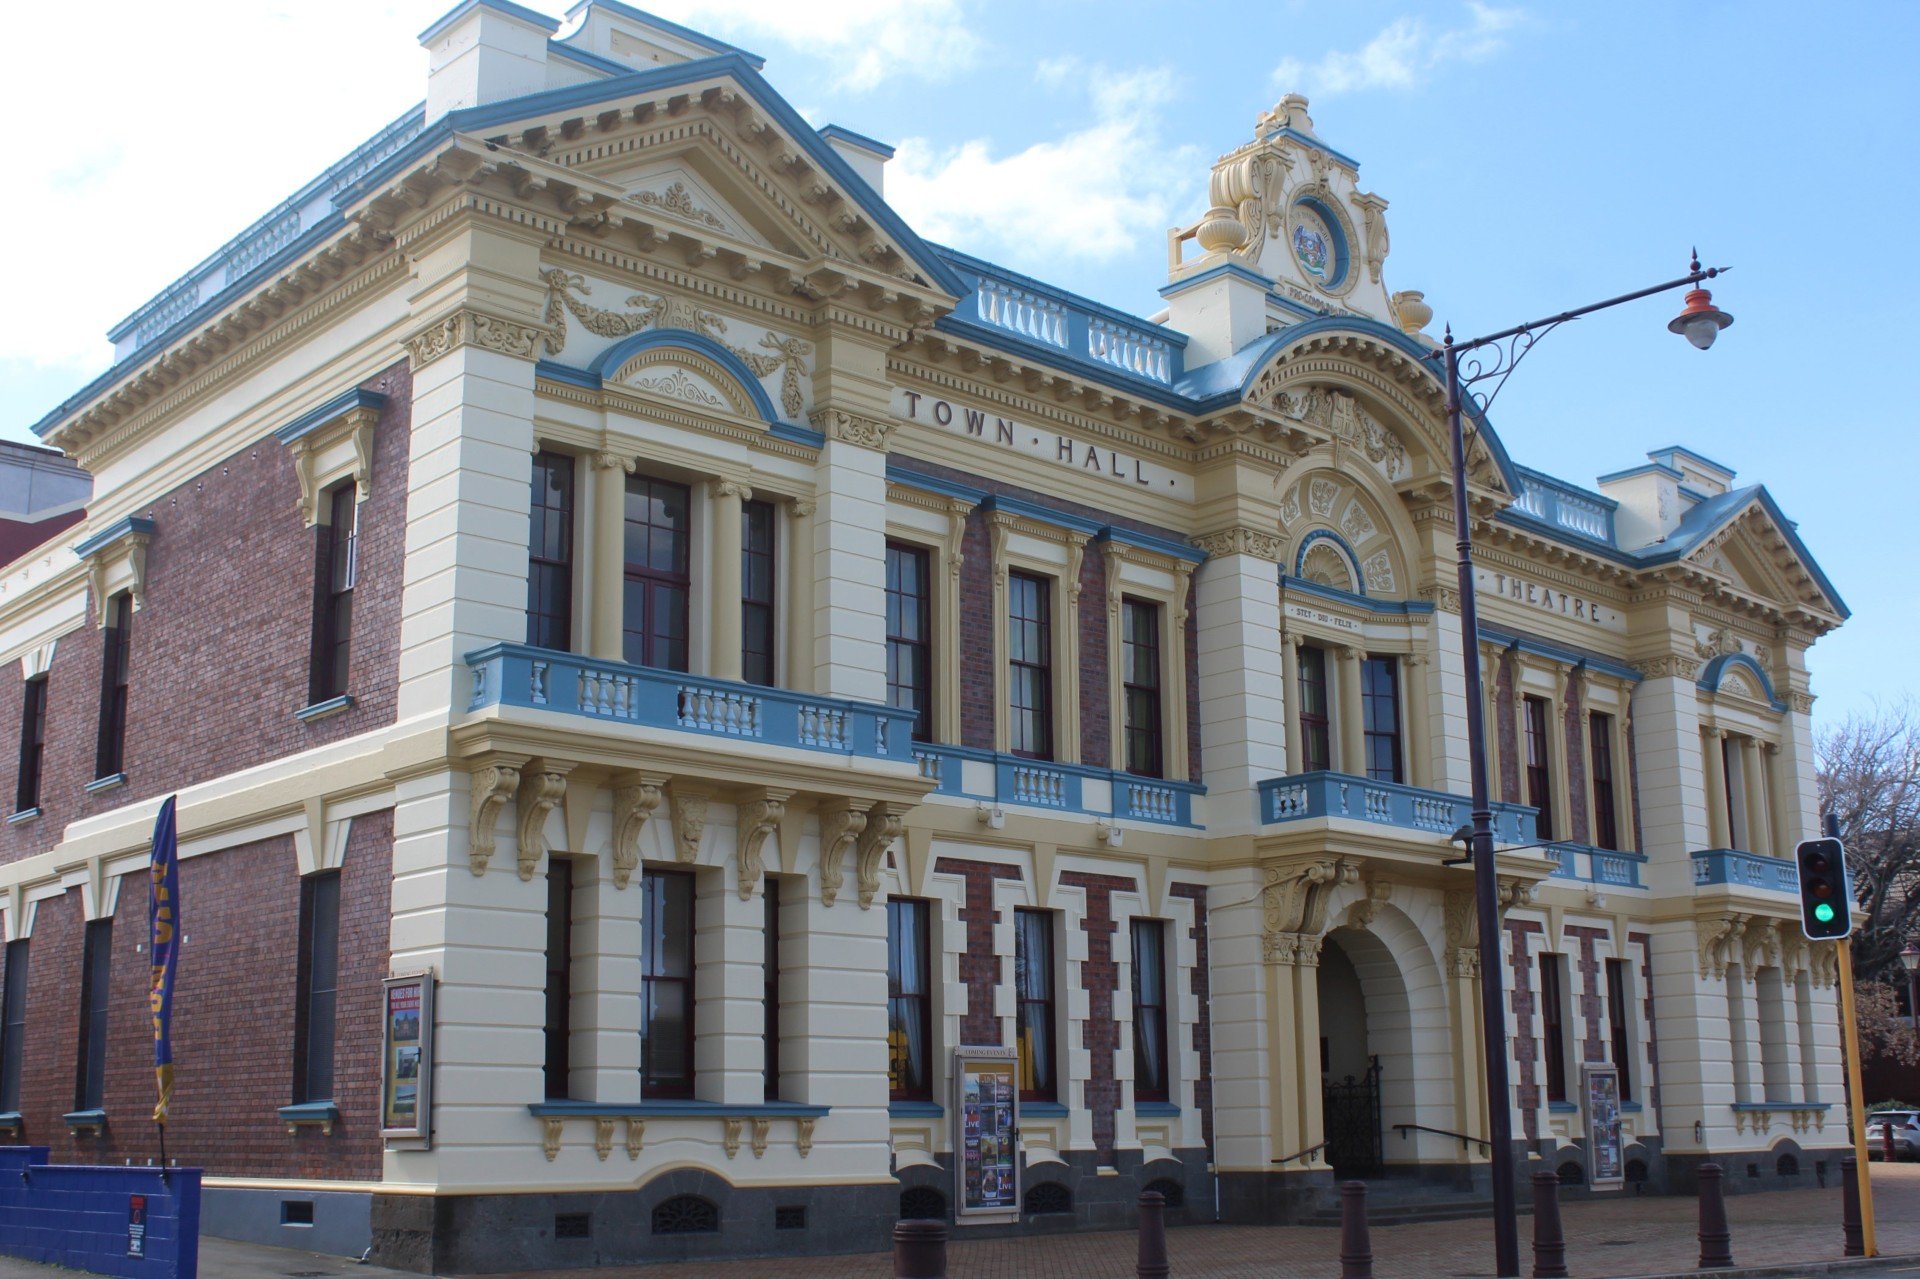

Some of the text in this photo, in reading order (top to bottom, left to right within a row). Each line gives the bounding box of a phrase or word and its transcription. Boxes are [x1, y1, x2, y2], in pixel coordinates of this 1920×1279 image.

[903, 390, 1150, 486] TOWN HALL
[1296, 608, 1312, 619] STET
[1334, 617, 1352, 629] FELIX
[1494, 573, 1600, 623] THEATRE
